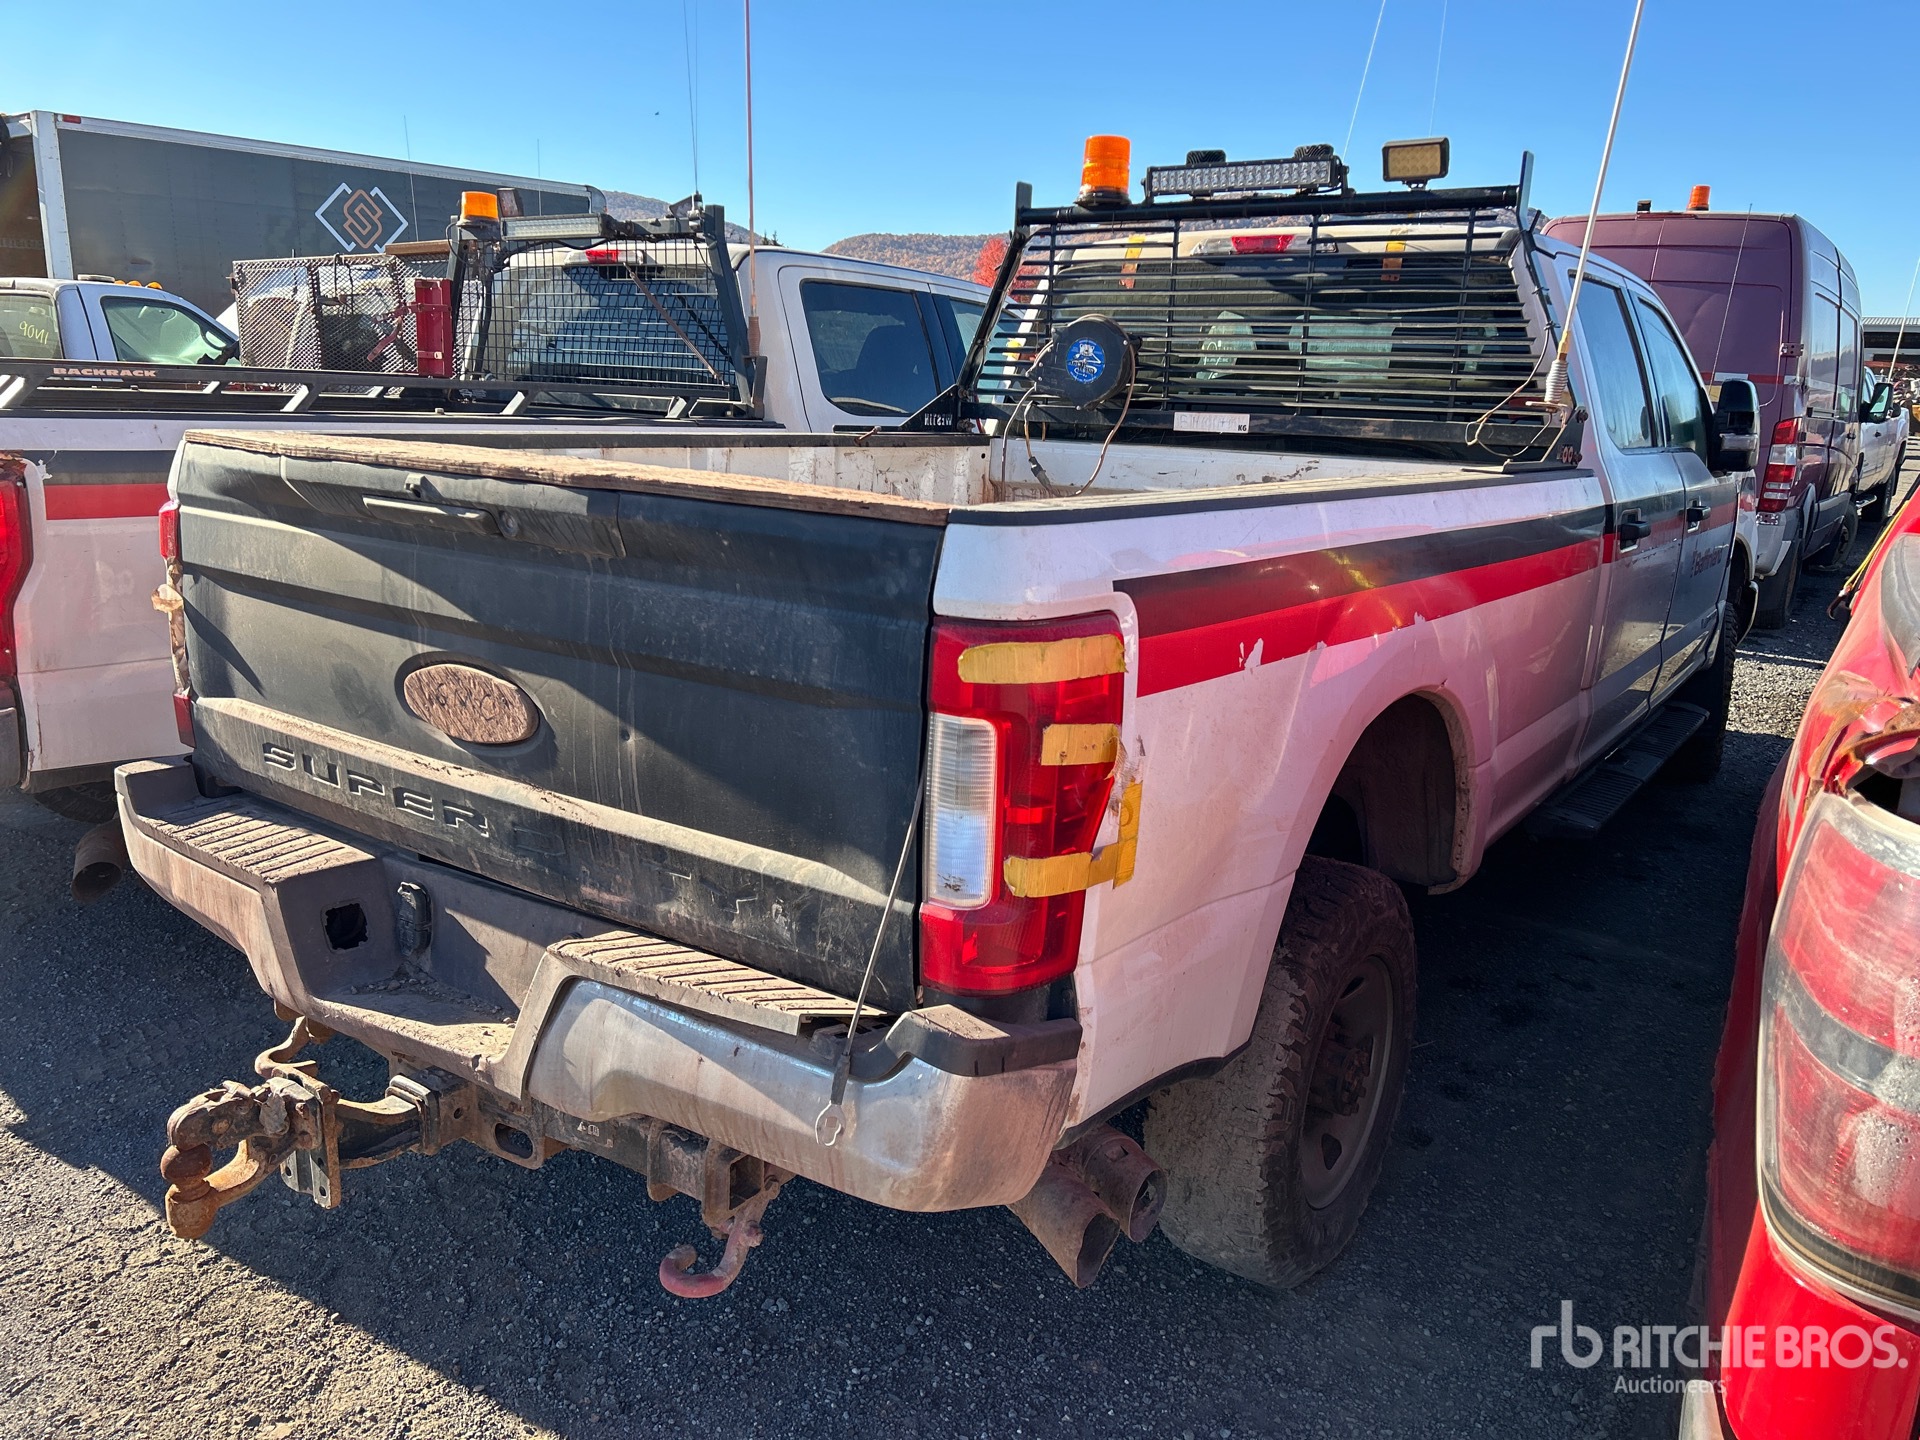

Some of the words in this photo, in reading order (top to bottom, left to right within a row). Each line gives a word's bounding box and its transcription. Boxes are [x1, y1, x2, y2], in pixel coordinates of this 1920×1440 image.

[53, 367, 157, 377] BACKRACK
[1237, 424, 1247, 432] KG
[262, 742, 489, 838] SUPER
